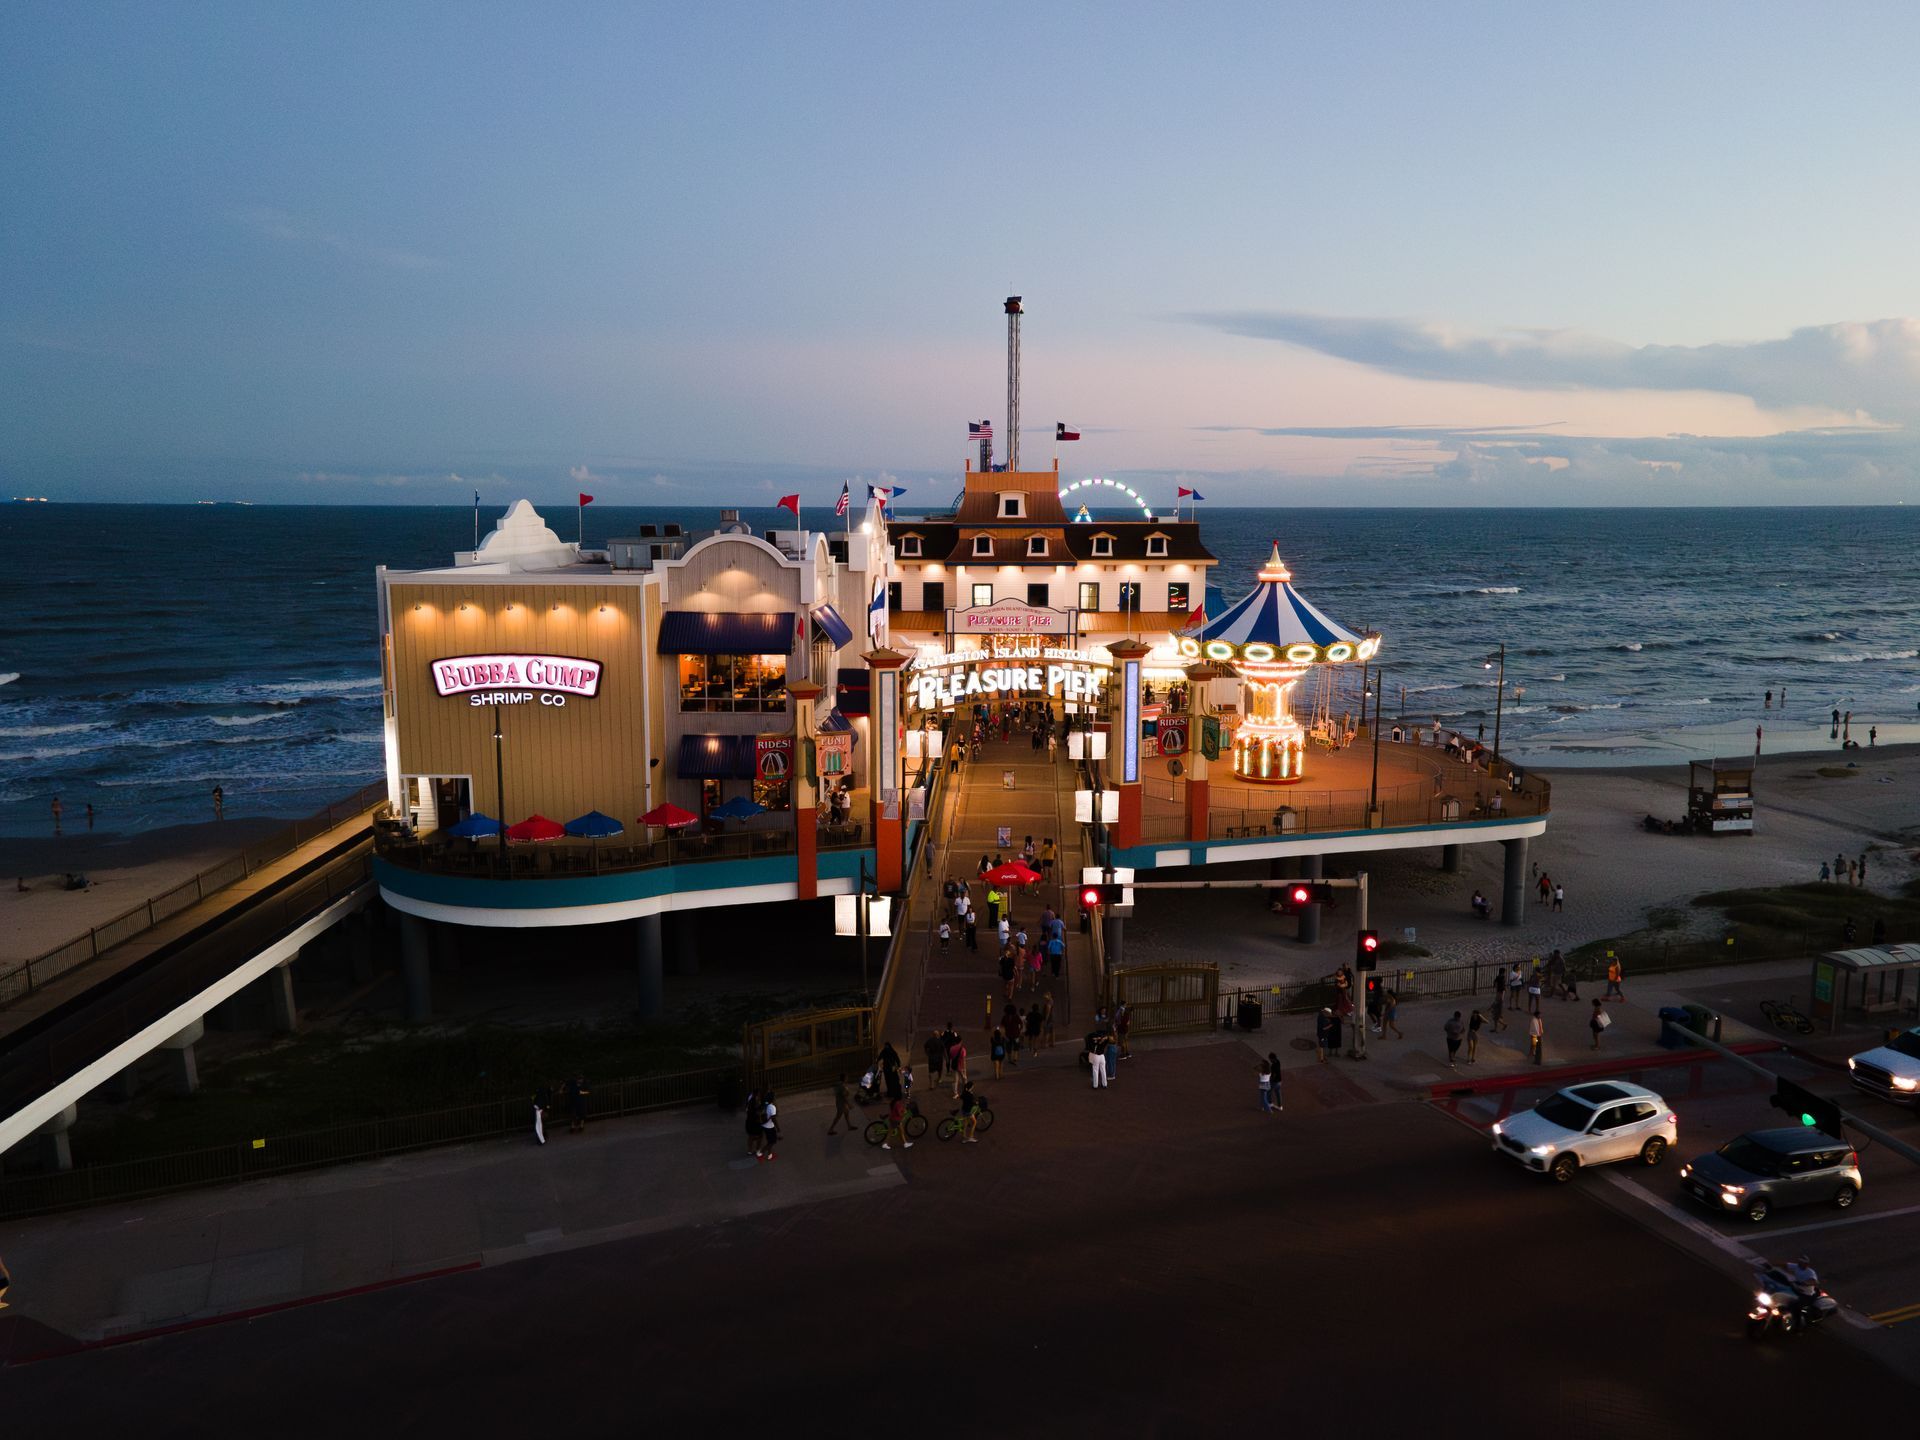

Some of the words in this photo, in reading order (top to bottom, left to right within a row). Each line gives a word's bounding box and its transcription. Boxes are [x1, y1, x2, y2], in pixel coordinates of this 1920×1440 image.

[968, 614, 1022, 627] PLEASURE
[1028, 614, 1052, 628] PIER
[994, 647, 1040, 658] ISLAND
[440, 661, 521, 690] BUBBA
[526, 657, 596, 689] GUMP
[918, 668, 1043, 708] PLEASURE
[1048, 665, 1100, 696] PIER
[470, 692, 533, 706] SHRIMP
[1160, 718, 1188, 727] RIDES!
[757, 740, 791, 749] RIDES!
[821, 736, 845, 745] FUN!
